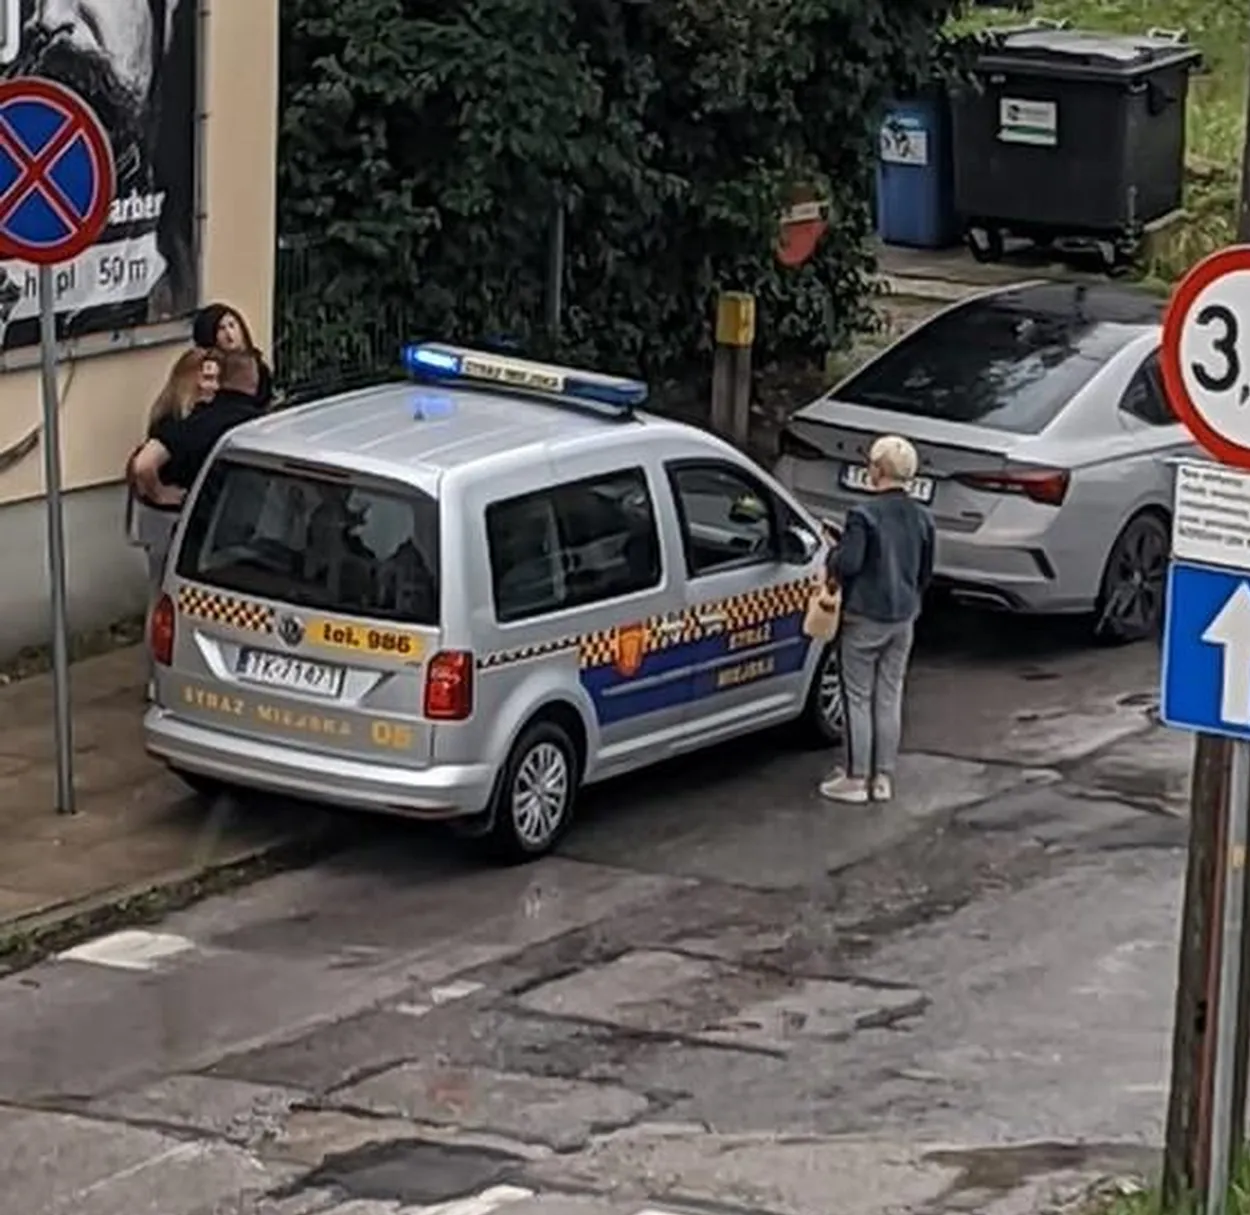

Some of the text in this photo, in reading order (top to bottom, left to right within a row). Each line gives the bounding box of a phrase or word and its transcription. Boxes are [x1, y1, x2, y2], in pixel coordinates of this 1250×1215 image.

[108, 190, 166, 225] arber
[324, 622, 411, 654] tel. 986
